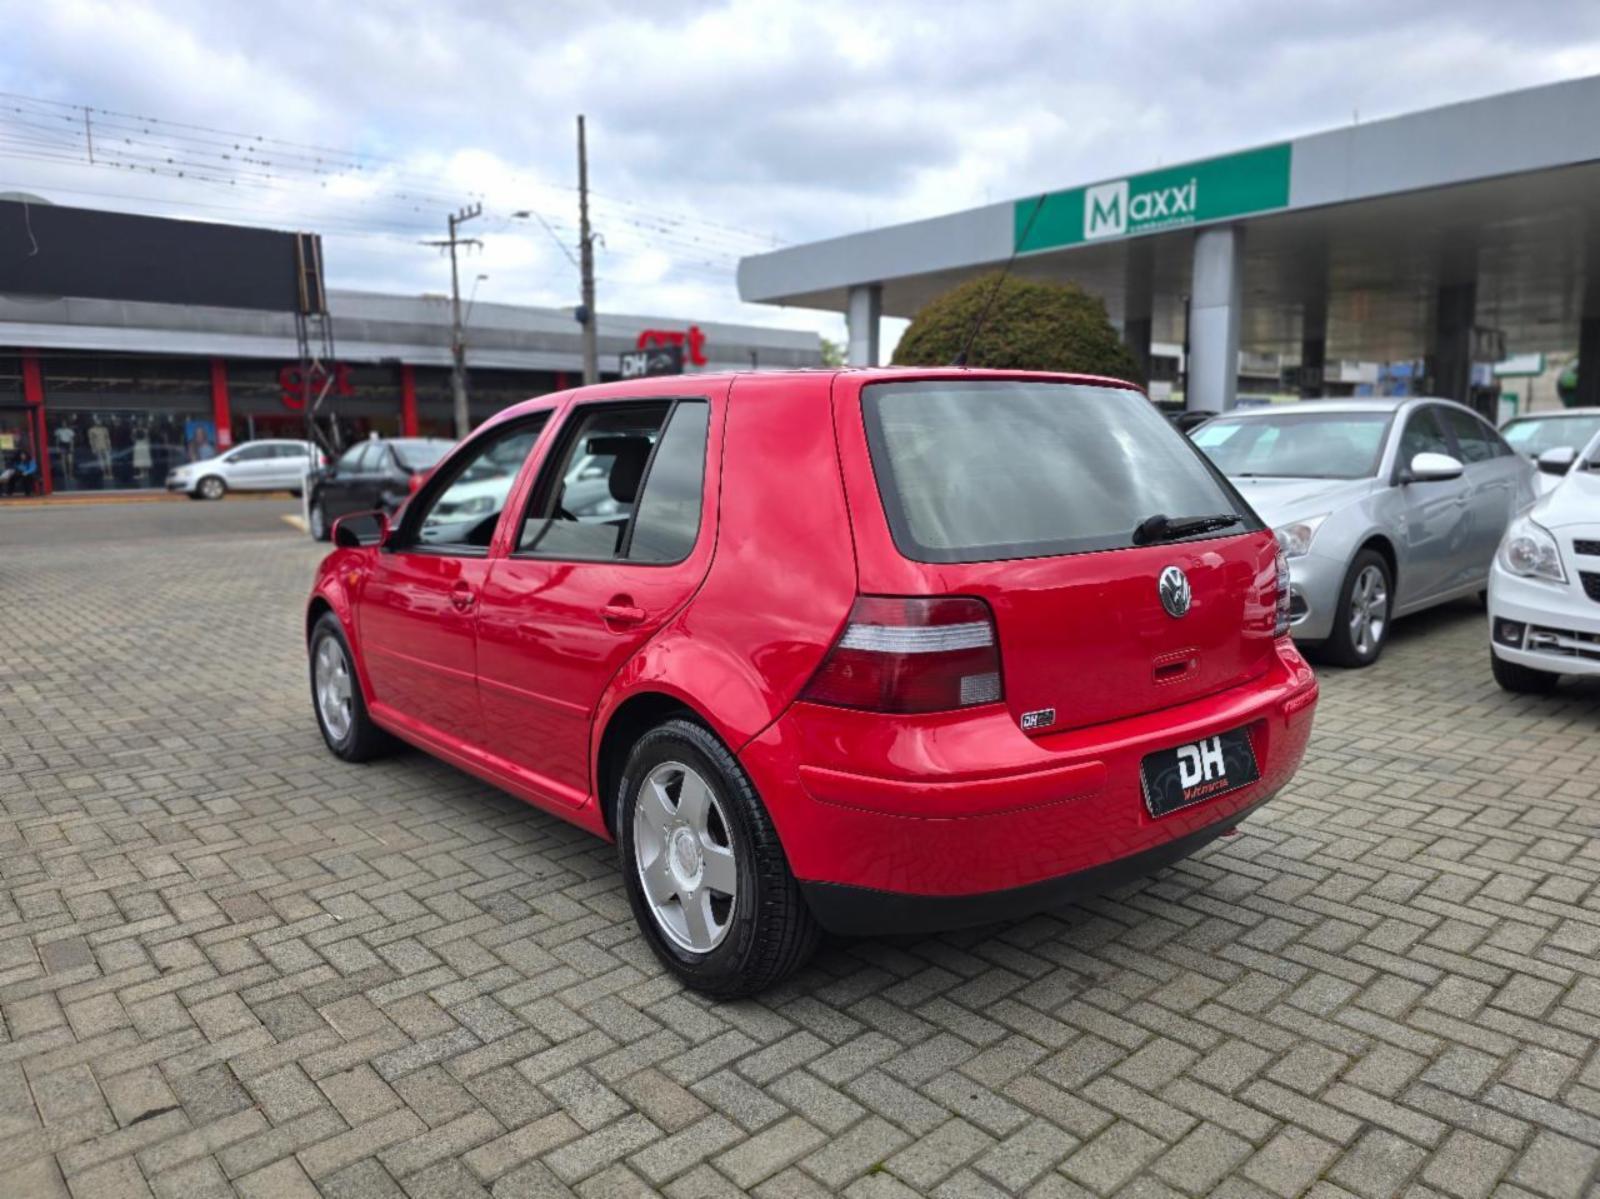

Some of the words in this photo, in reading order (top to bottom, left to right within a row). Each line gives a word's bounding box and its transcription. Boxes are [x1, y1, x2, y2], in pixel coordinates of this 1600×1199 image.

[1089, 177, 1197, 233] Maxxi
[621, 352, 648, 377] DH
[1023, 714, 1038, 728] DH
[1177, 735, 1226, 789] DH
